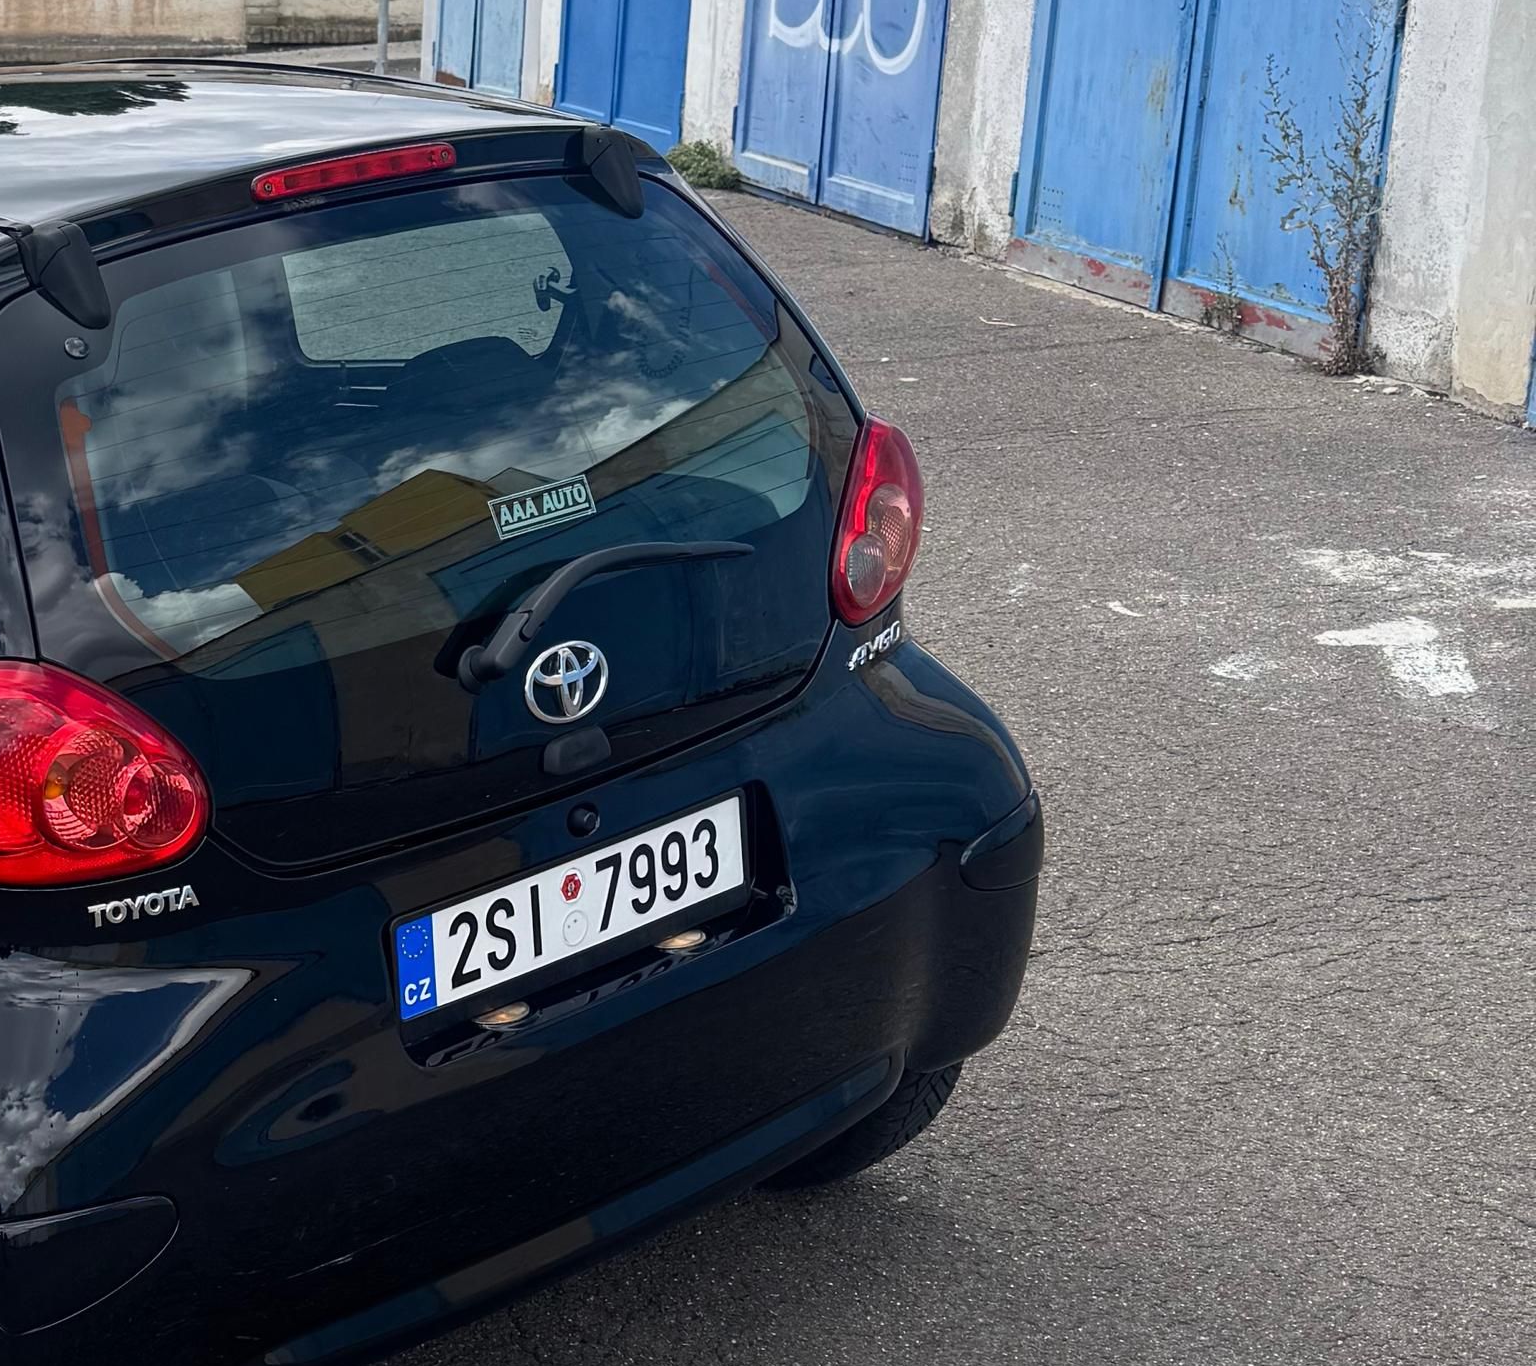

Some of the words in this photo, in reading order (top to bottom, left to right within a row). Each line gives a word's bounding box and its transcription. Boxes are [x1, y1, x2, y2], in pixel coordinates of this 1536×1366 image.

[500, 497, 539, 526] AAA
[543, 483, 587, 514] AUTO
[87, 884, 200, 928] TOYOTA
[403, 976, 432, 1006] CZ
[448, 884, 544, 991] 2SI
[595, 818, 720, 933] 7993
